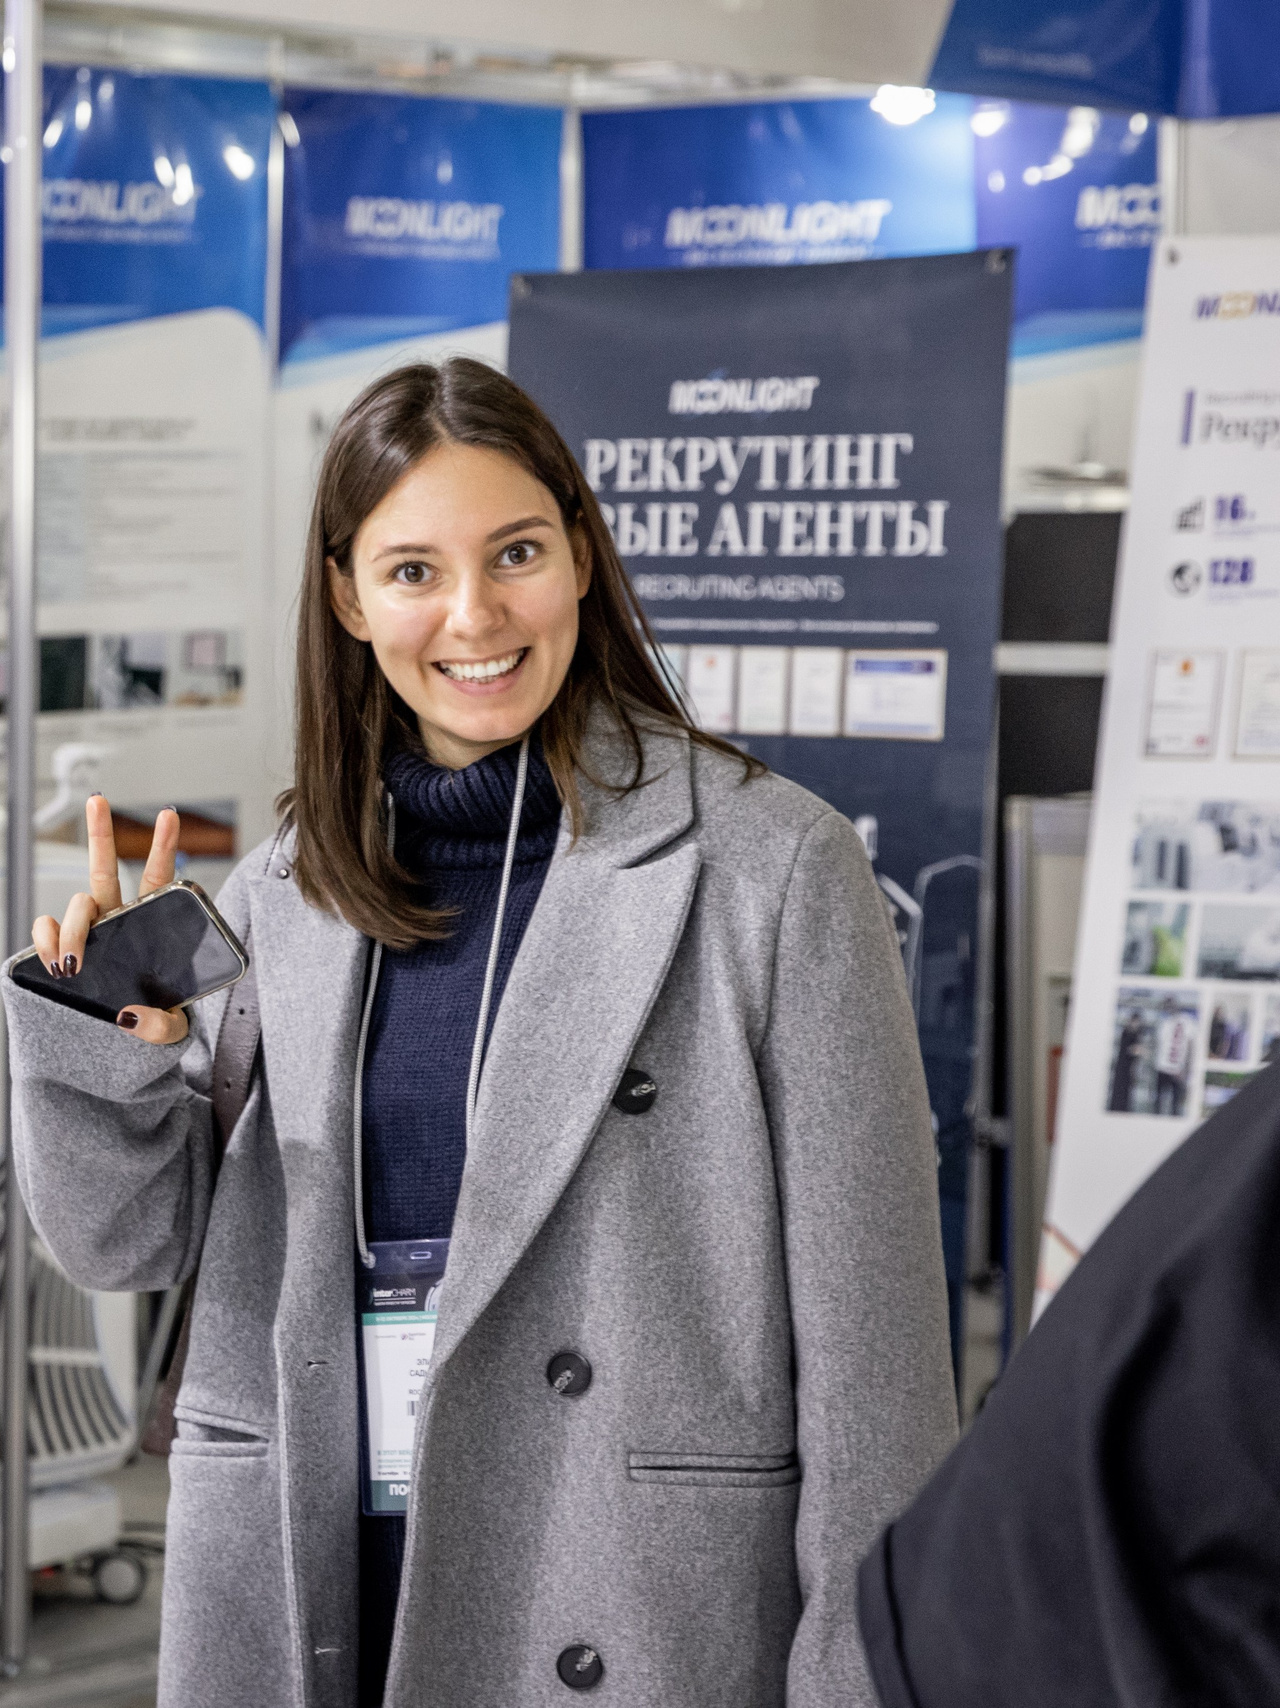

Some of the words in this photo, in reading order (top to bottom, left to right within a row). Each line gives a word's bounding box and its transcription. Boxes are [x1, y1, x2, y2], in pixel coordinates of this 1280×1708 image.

[345, 196, 505, 240] MOONLIGHT
[664, 199, 892, 247] MOONLIGHT
[1076, 184, 1161, 229] MOO
[669, 377, 819, 414] MOONLIGHT
[585, 433, 914, 494] РЕКРУТИНГ
[707, 500, 949, 557] АГЕНТЫ
[633, 573, 755, 601] RECRUITING
[756, 573, 845, 603] AGENTS
[373, 1287, 417, 1298] interCHARM
[409, 1369, 426, 1377] САД
[388, 1483, 411, 1497] ПО
